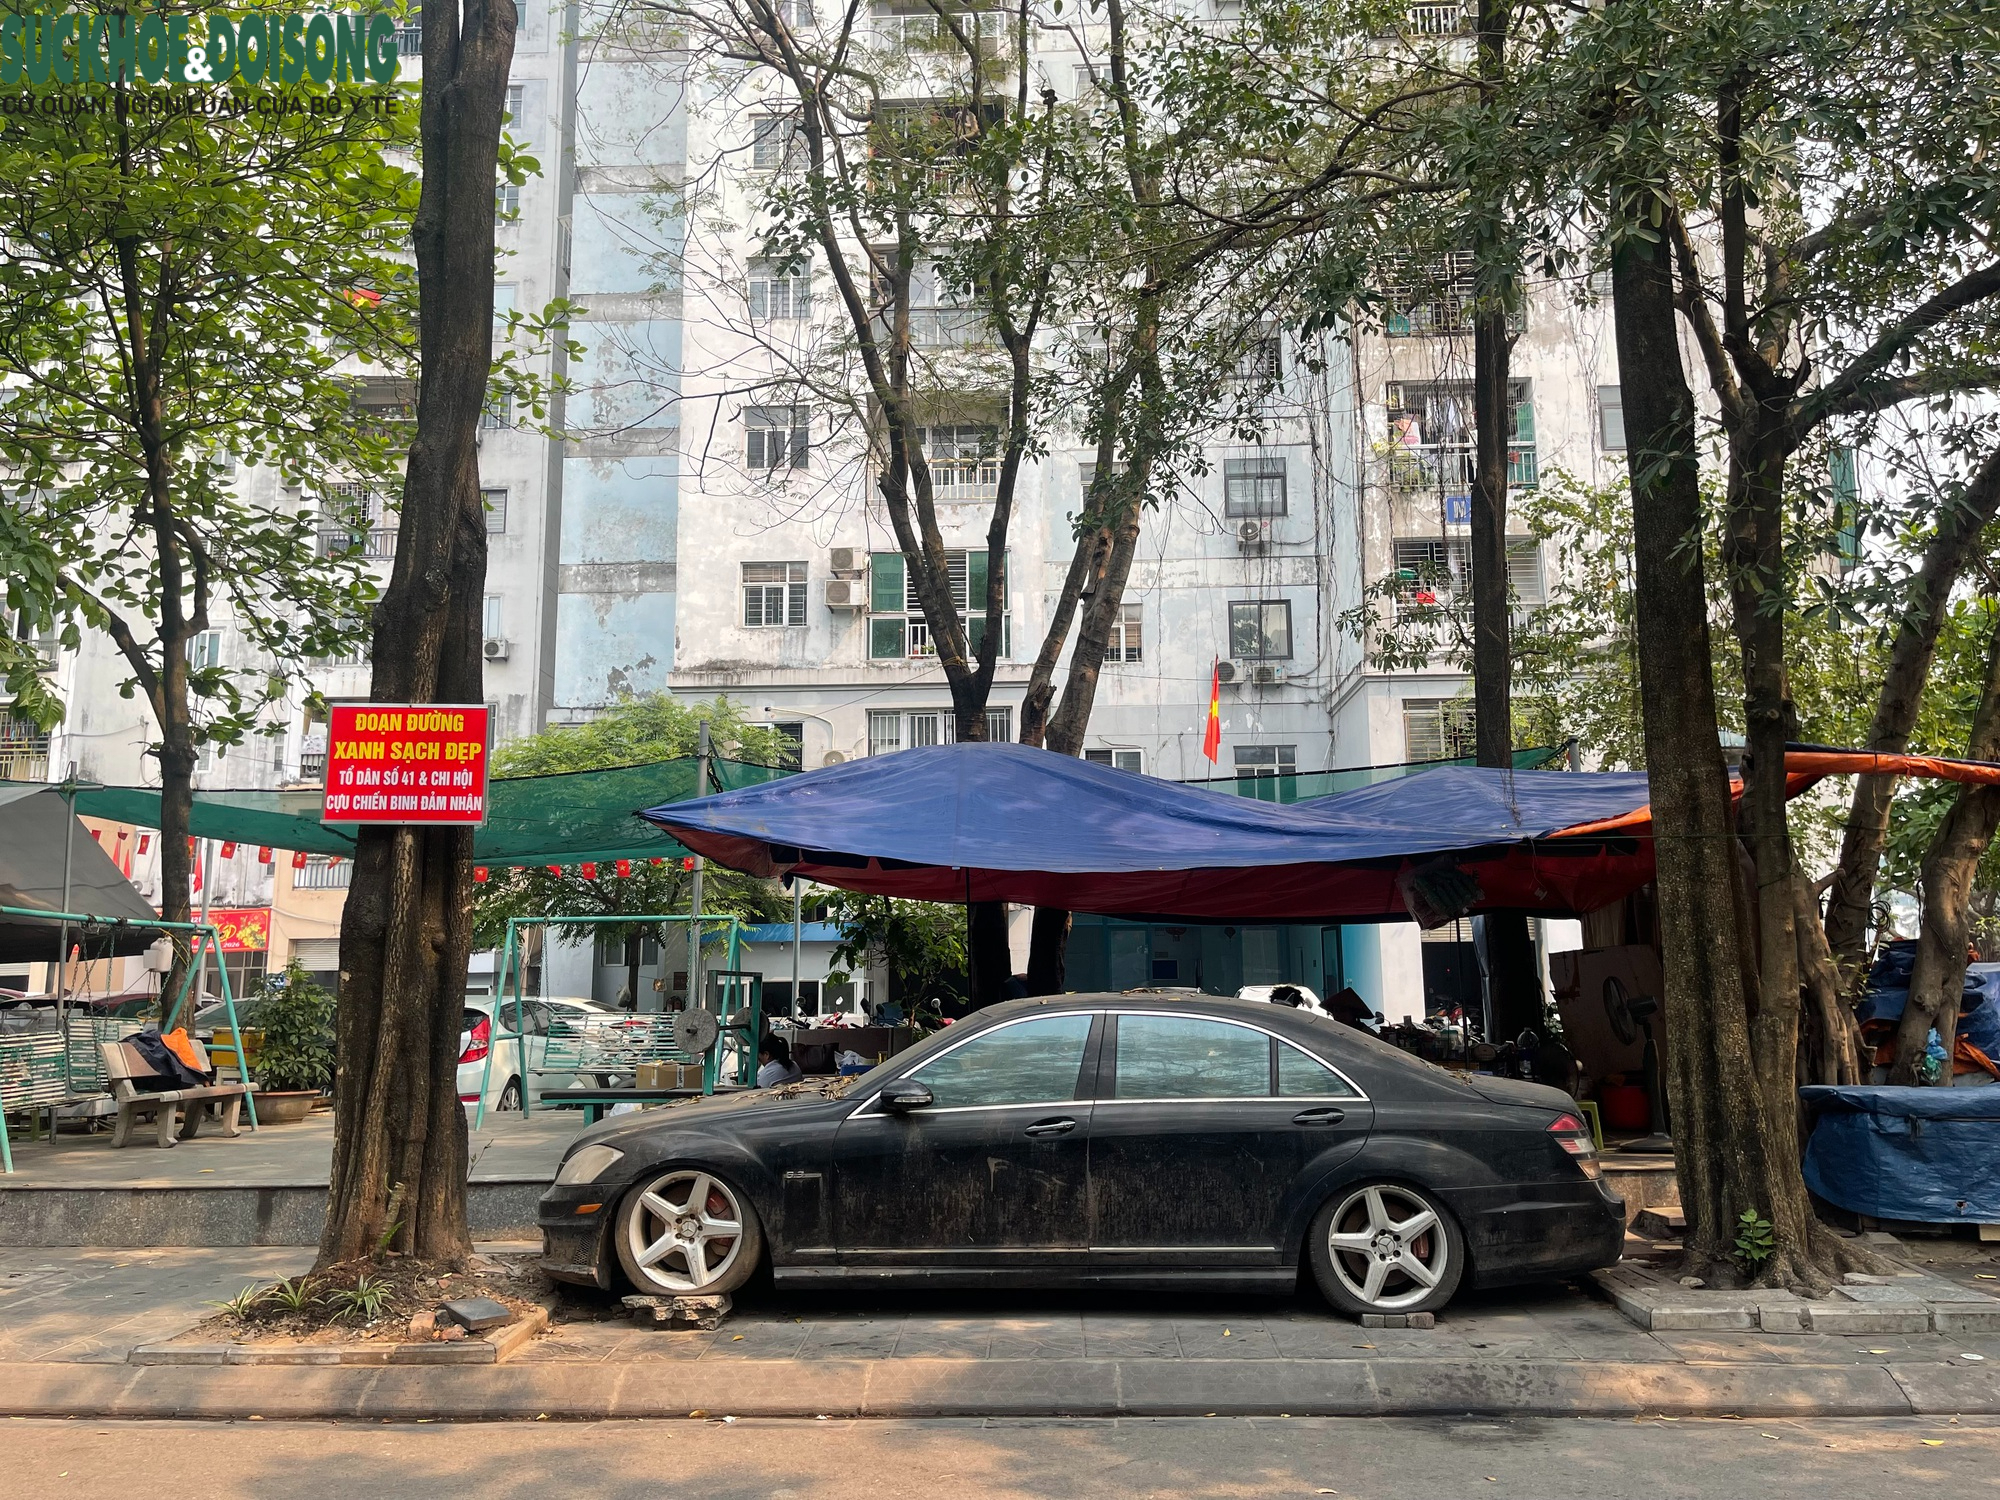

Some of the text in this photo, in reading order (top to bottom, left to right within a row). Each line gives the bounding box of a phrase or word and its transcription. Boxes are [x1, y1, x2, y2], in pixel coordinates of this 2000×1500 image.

[355, 710, 465, 735] ĐOẠN ĐƯỜNG
[333, 741, 482, 765] XANH SẠCH ĐẸP
[339, 765, 473, 789] TỔ DÂN SỐ 41 & CHI HỘI
[326, 791, 483, 814] CỰU CHIẾN BINH ĐẢM NHẬN
